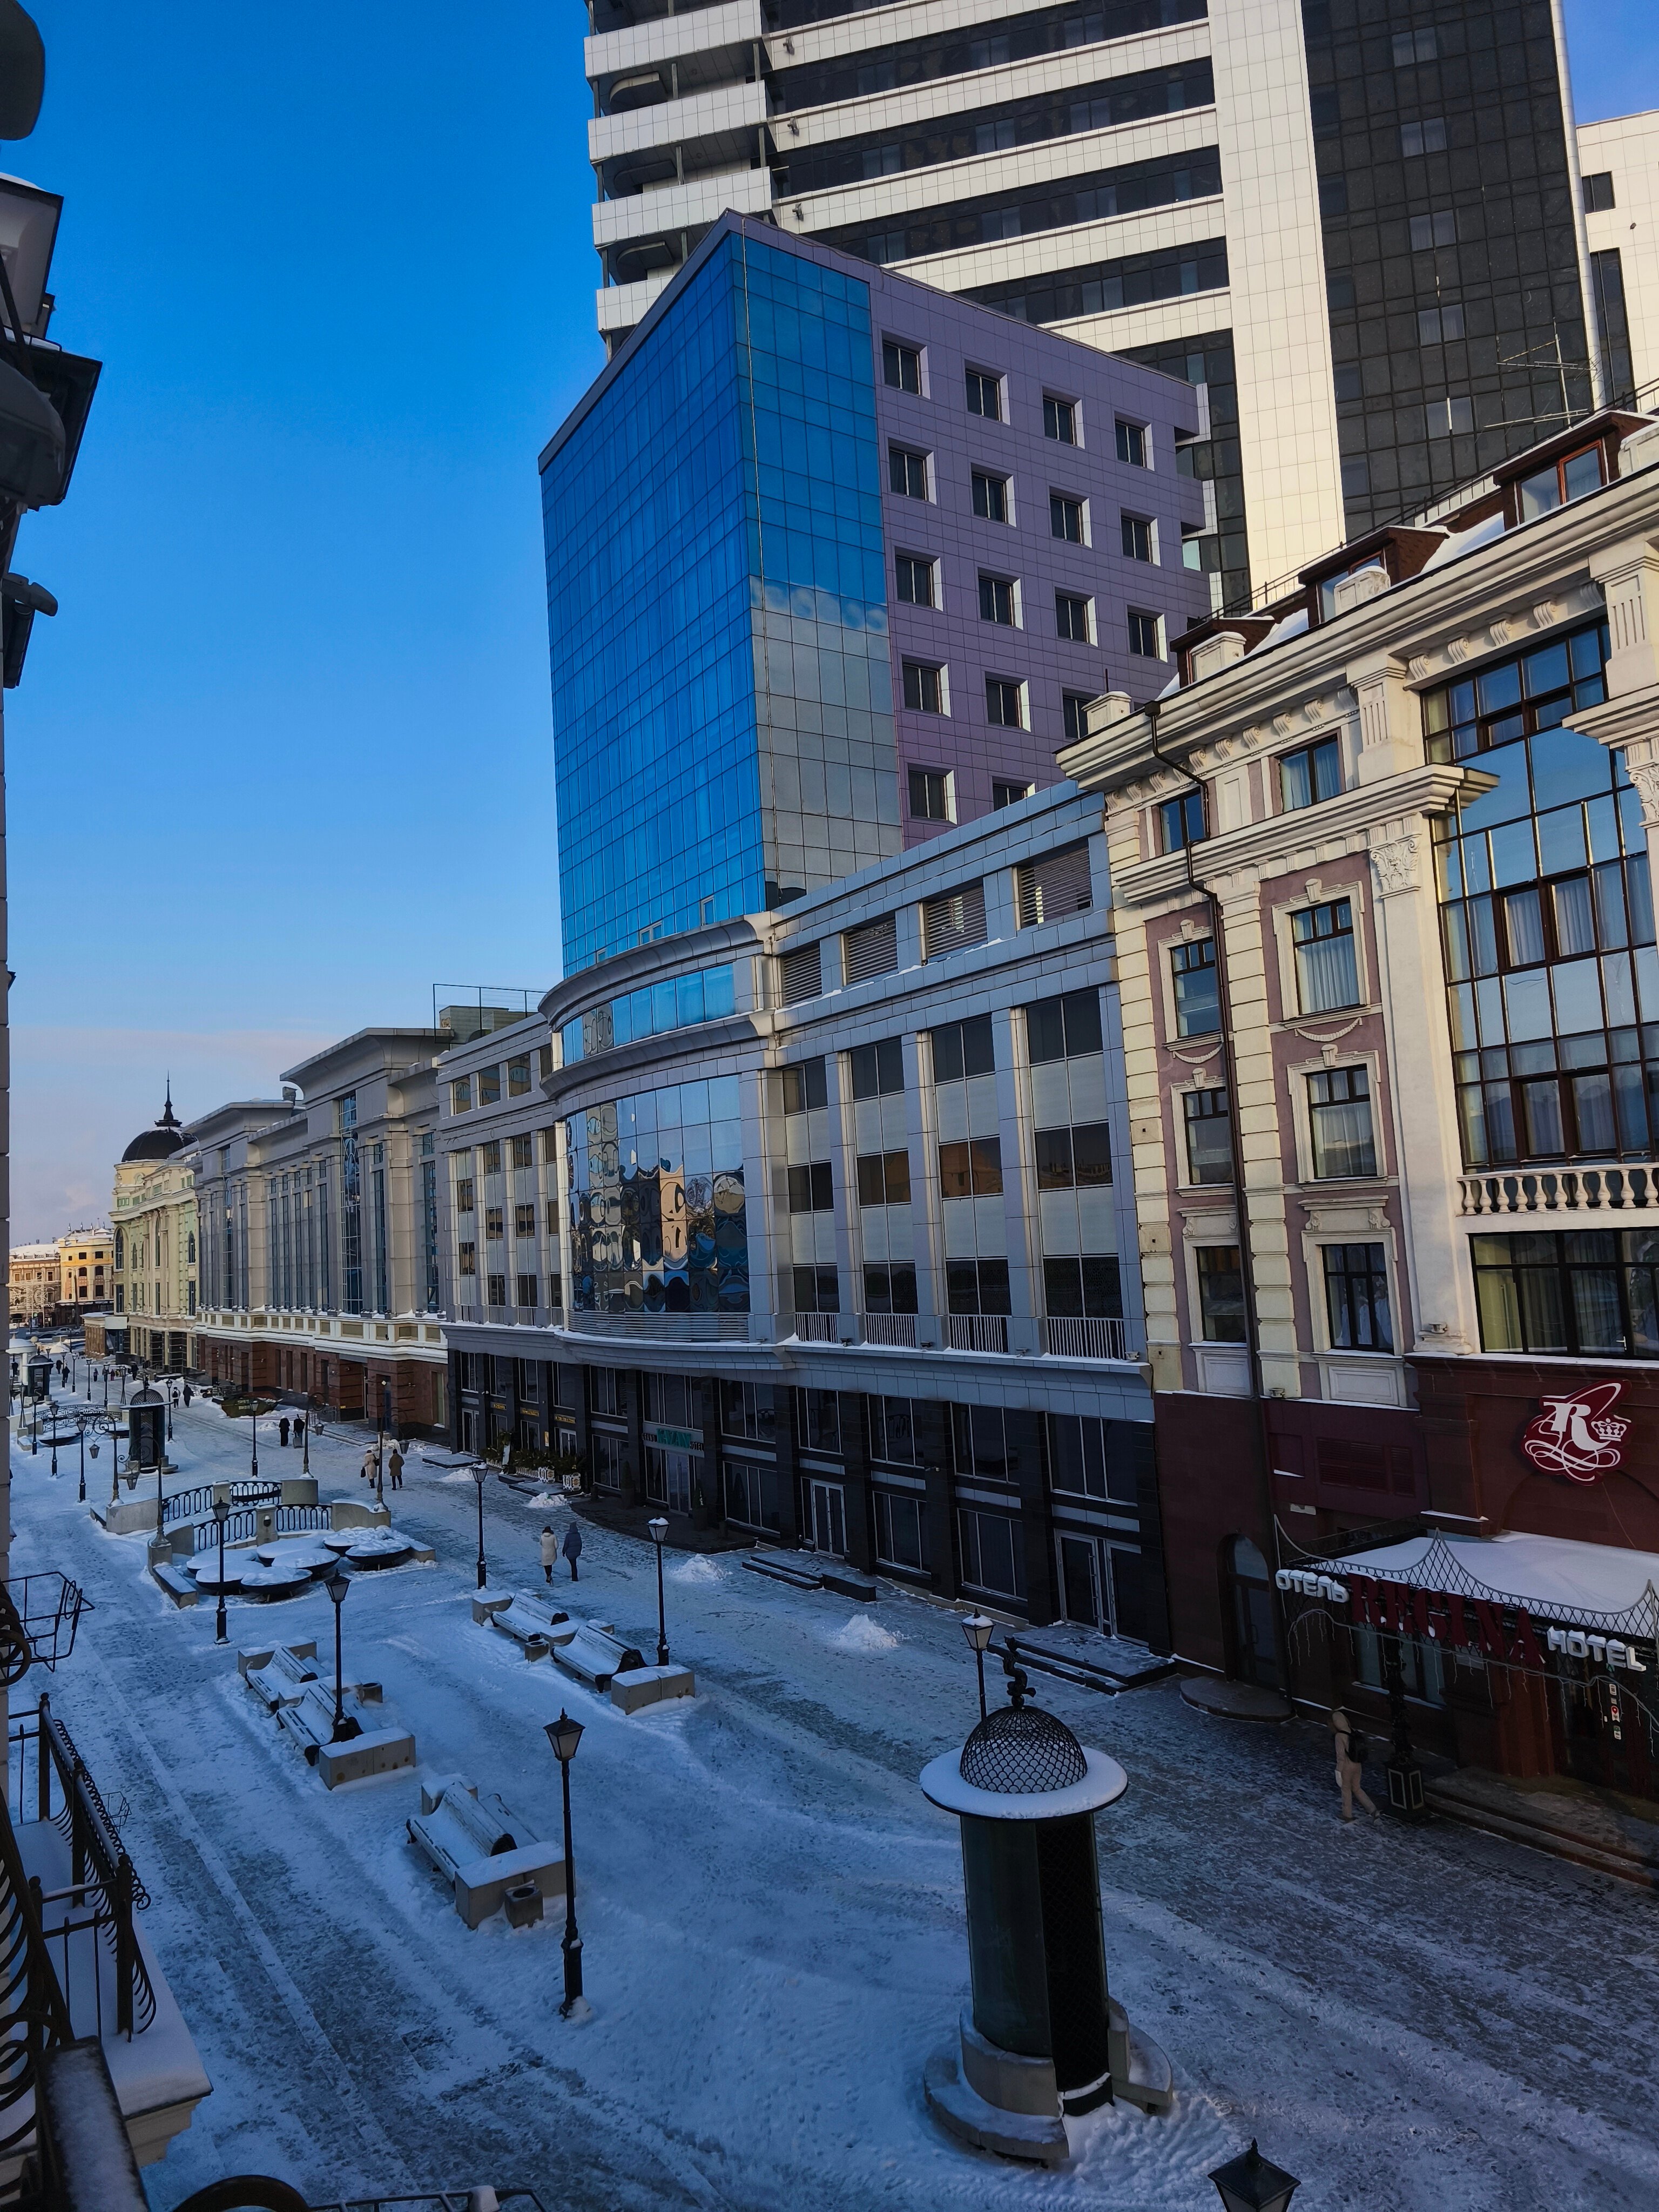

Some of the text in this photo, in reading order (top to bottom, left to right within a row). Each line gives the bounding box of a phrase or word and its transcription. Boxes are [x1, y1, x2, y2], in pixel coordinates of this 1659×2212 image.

[642, 1429, 704, 1452] GRAND KAZAN HOTEL
[1275, 1569, 1350, 1603] ОТЕЛЬ
[1348, 1573, 1546, 1664] REGINA
[1546, 1626, 1647, 1672] HOTEL
